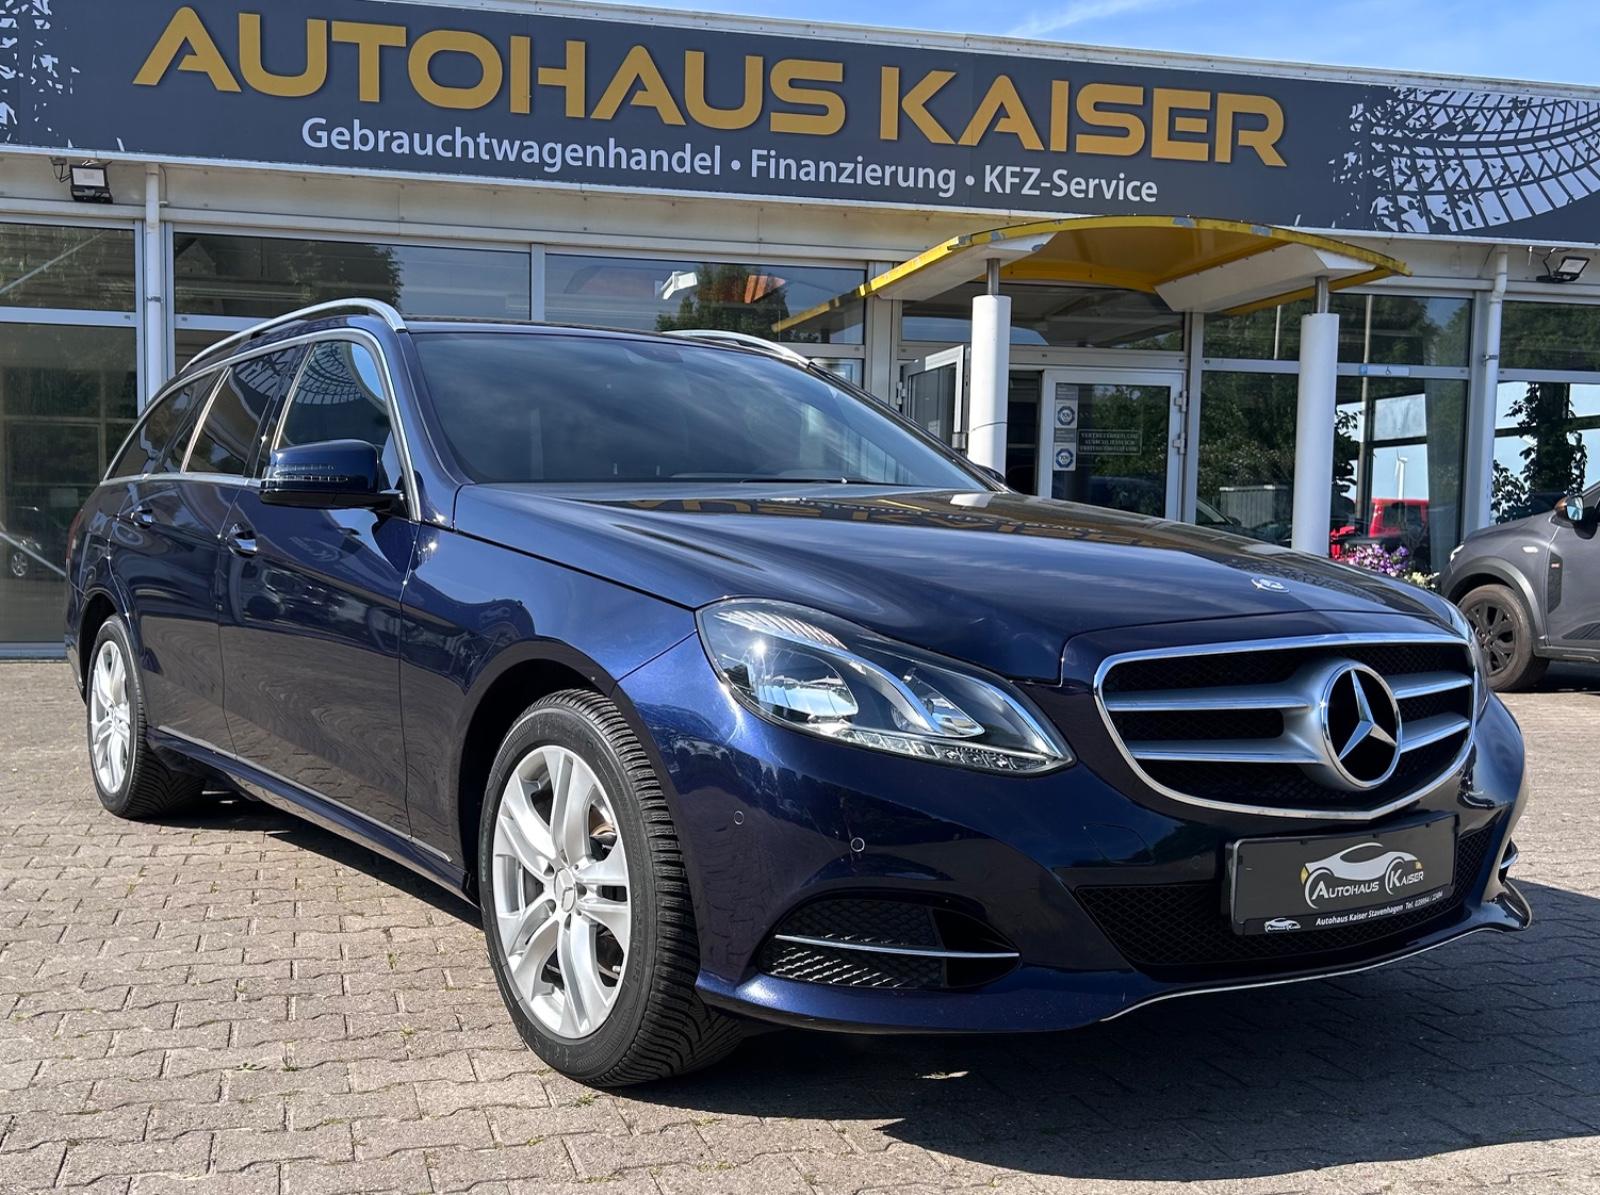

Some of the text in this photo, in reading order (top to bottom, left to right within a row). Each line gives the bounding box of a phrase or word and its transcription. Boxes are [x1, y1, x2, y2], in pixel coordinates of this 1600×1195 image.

[135, 9, 1286, 168] AUTOHAUS KAISER
[301, 116, 1158, 203] Gebrauchtwagenhandel Finanzierung KFZ-Service
[1316, 916, 1348, 926] Autohaus
[1349, 912, 1368, 922] Kaiser
